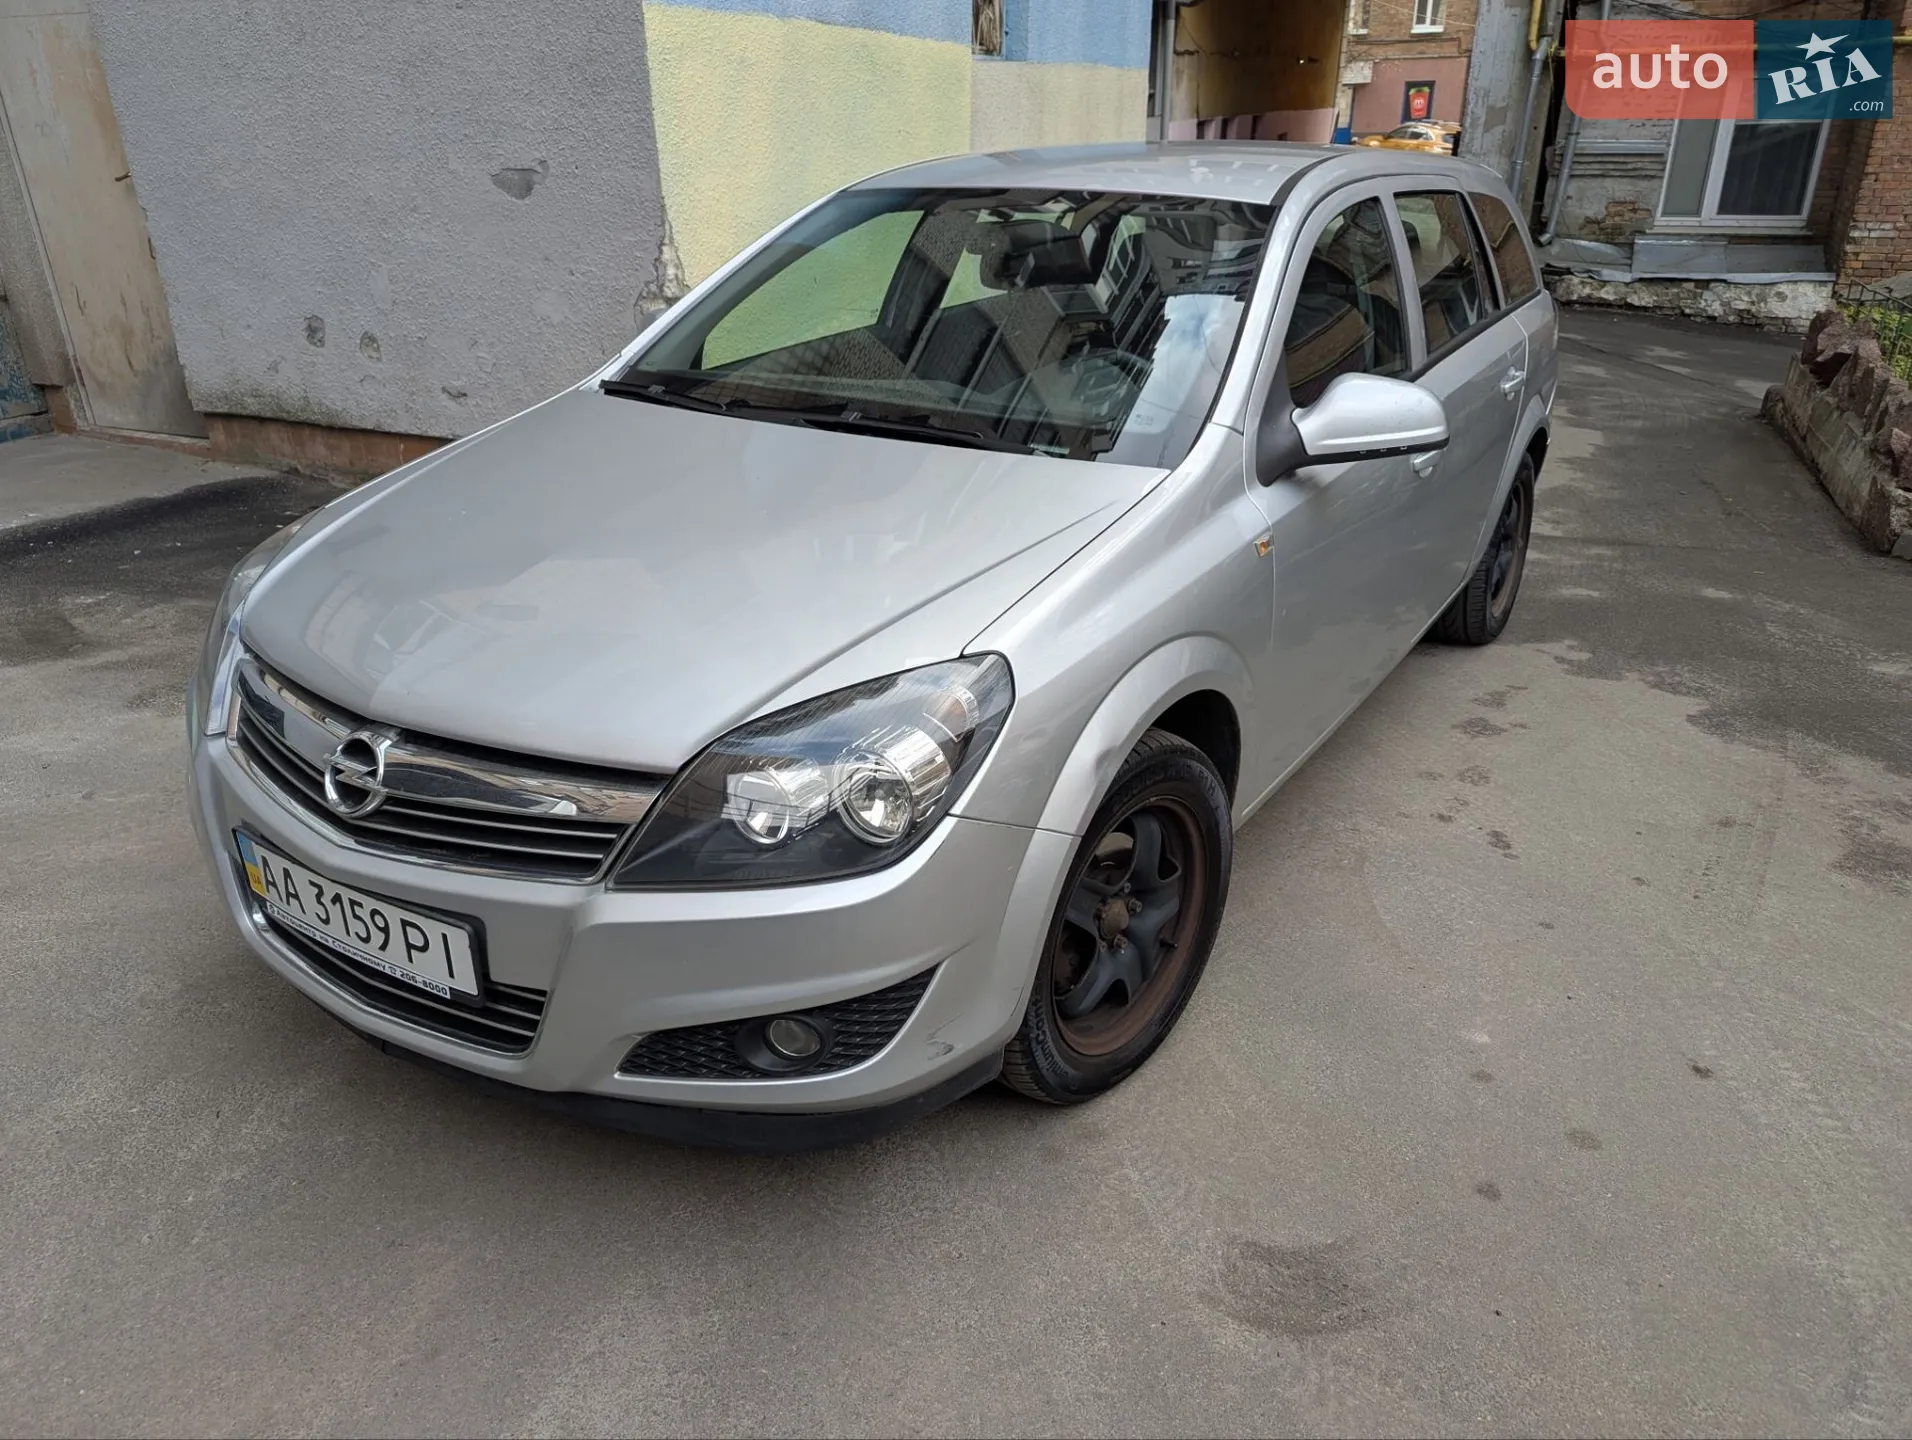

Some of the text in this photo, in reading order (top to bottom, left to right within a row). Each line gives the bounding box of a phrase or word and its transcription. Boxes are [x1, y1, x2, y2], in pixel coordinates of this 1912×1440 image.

[261, 854, 454, 979] AA 3159 PI
